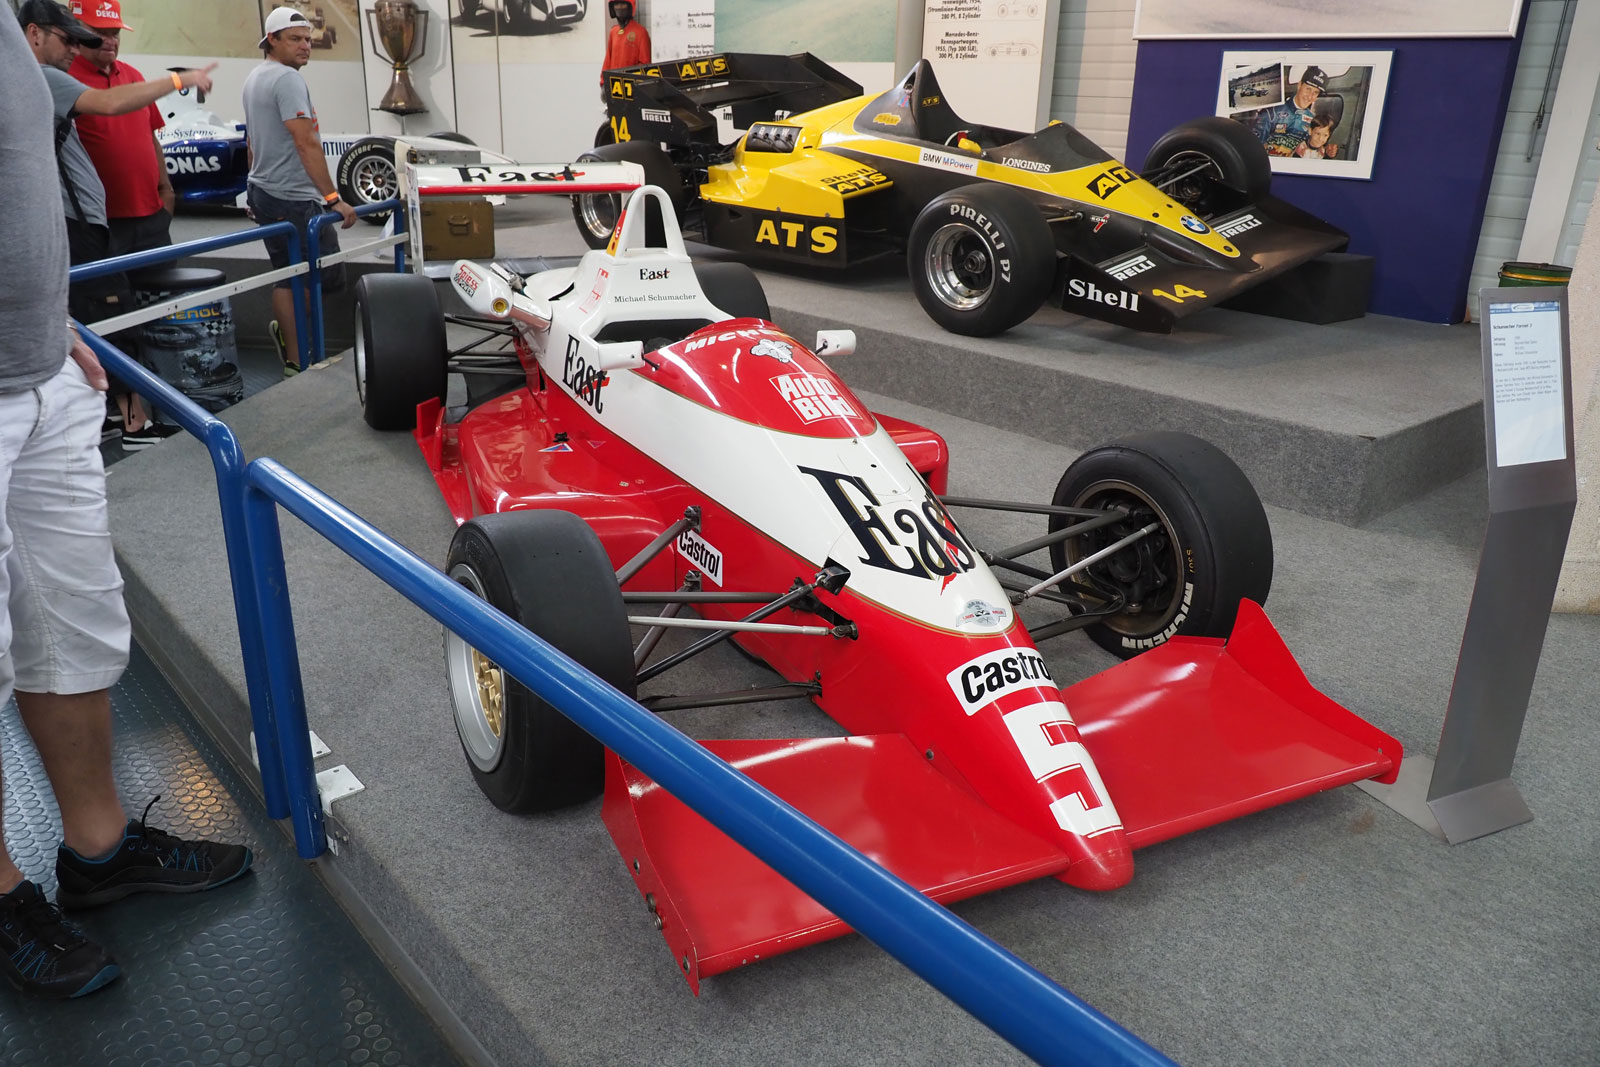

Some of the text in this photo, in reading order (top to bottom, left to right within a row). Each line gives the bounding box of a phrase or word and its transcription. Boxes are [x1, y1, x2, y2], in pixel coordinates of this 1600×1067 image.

[95, 9, 120, 19] DEKRA
[962, 12, 981, 20] Zylinder
[940, 38, 979, 46] Rennsportwagen,
[959, 52, 978, 60] Zylinder
[681, 58, 727, 77] ATS
[641, 108, 671, 123] PIRELLI
[611, 115, 632, 144] 14
[162, 146, 199, 154] MALAYSIA
[322, 141, 353, 156] NTIU
[922, 152, 943, 165] BMW
[164, 155, 221, 175] ONAS
[340, 144, 372, 186] BRIDGESTONE
[452, 165, 577, 183] East
[1001, 157, 1051, 173] LONGINES
[837, 173, 888, 193] ATS
[755, 219, 838, 254] ATS
[950, 204, 1011, 283] PIRELLI P7
[459, 264, 481, 291] Spiess
[639, 267, 670, 281] East
[614, 292, 697, 303] Michael Schumacher
[1068, 278, 1139, 313] Shell
[1152, 284, 1207, 303] 14
[684, 328, 777, 354] MICHE
[562, 334, 607, 415] East
[777, 373, 838, 402] Auto
[792, 396, 858, 421] Bild
[679, 531, 720, 578] Castrol
[1121, 582, 1194, 649] MICHELIN
[961, 651, 1053, 704] Castro
